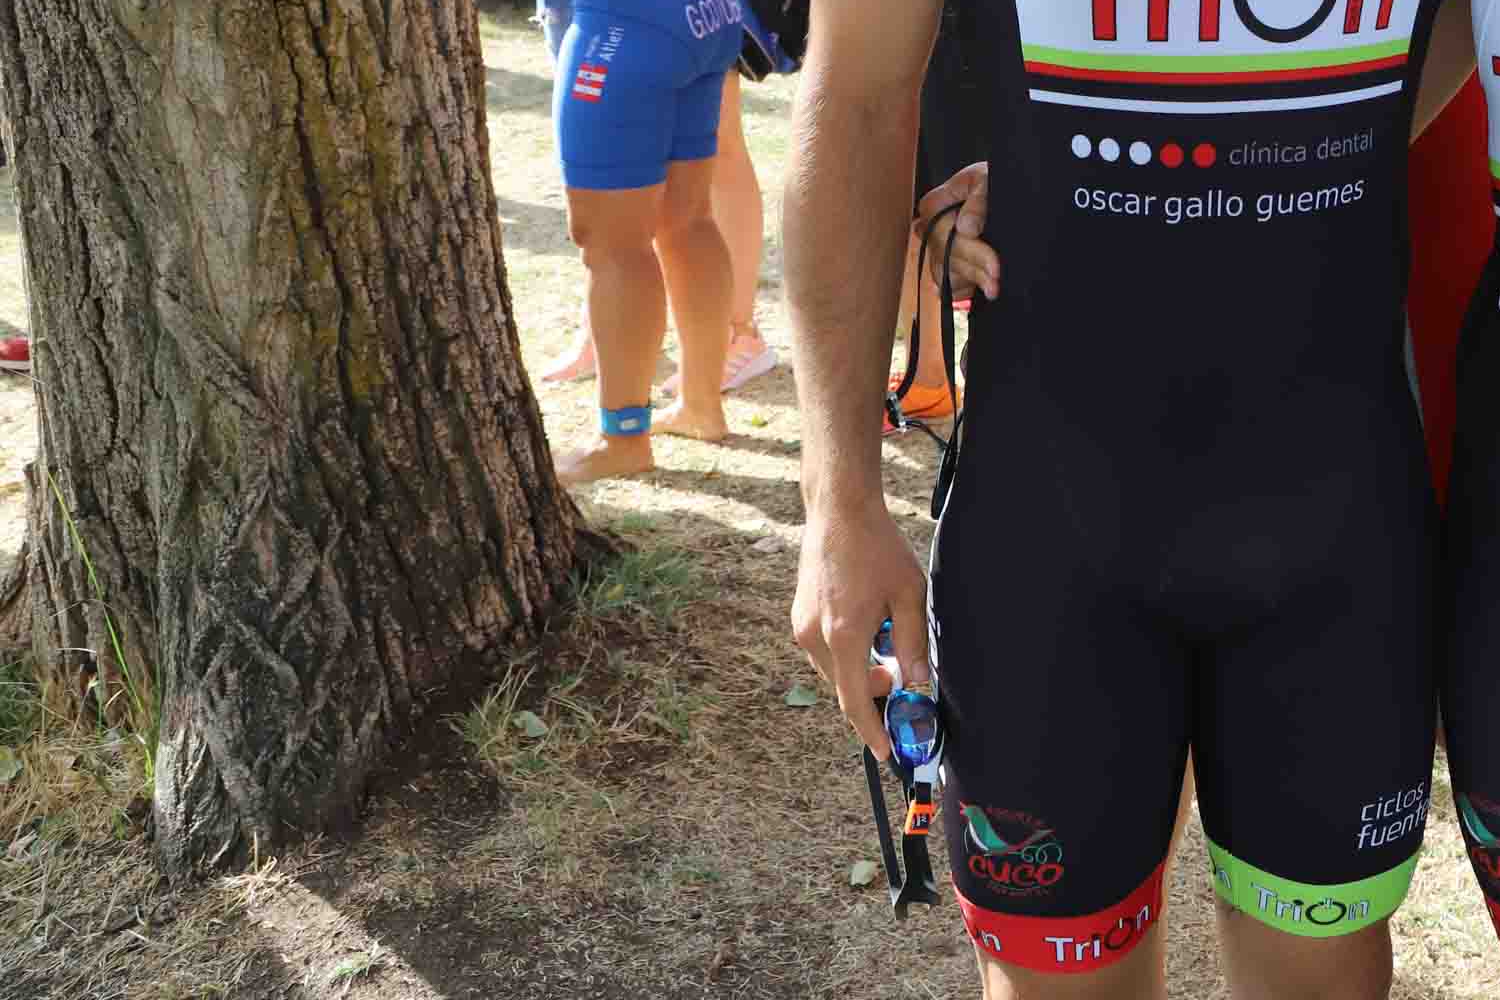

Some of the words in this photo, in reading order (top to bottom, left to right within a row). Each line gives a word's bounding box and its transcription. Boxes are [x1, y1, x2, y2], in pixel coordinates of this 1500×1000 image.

[1316, 127, 1373, 160] dental
[1074, 187, 1157, 216] oscar
[1164, 189, 1244, 225] gallo
[1256, 179, 1365, 223] guemes
[1361, 782, 1425, 822] ciclos
